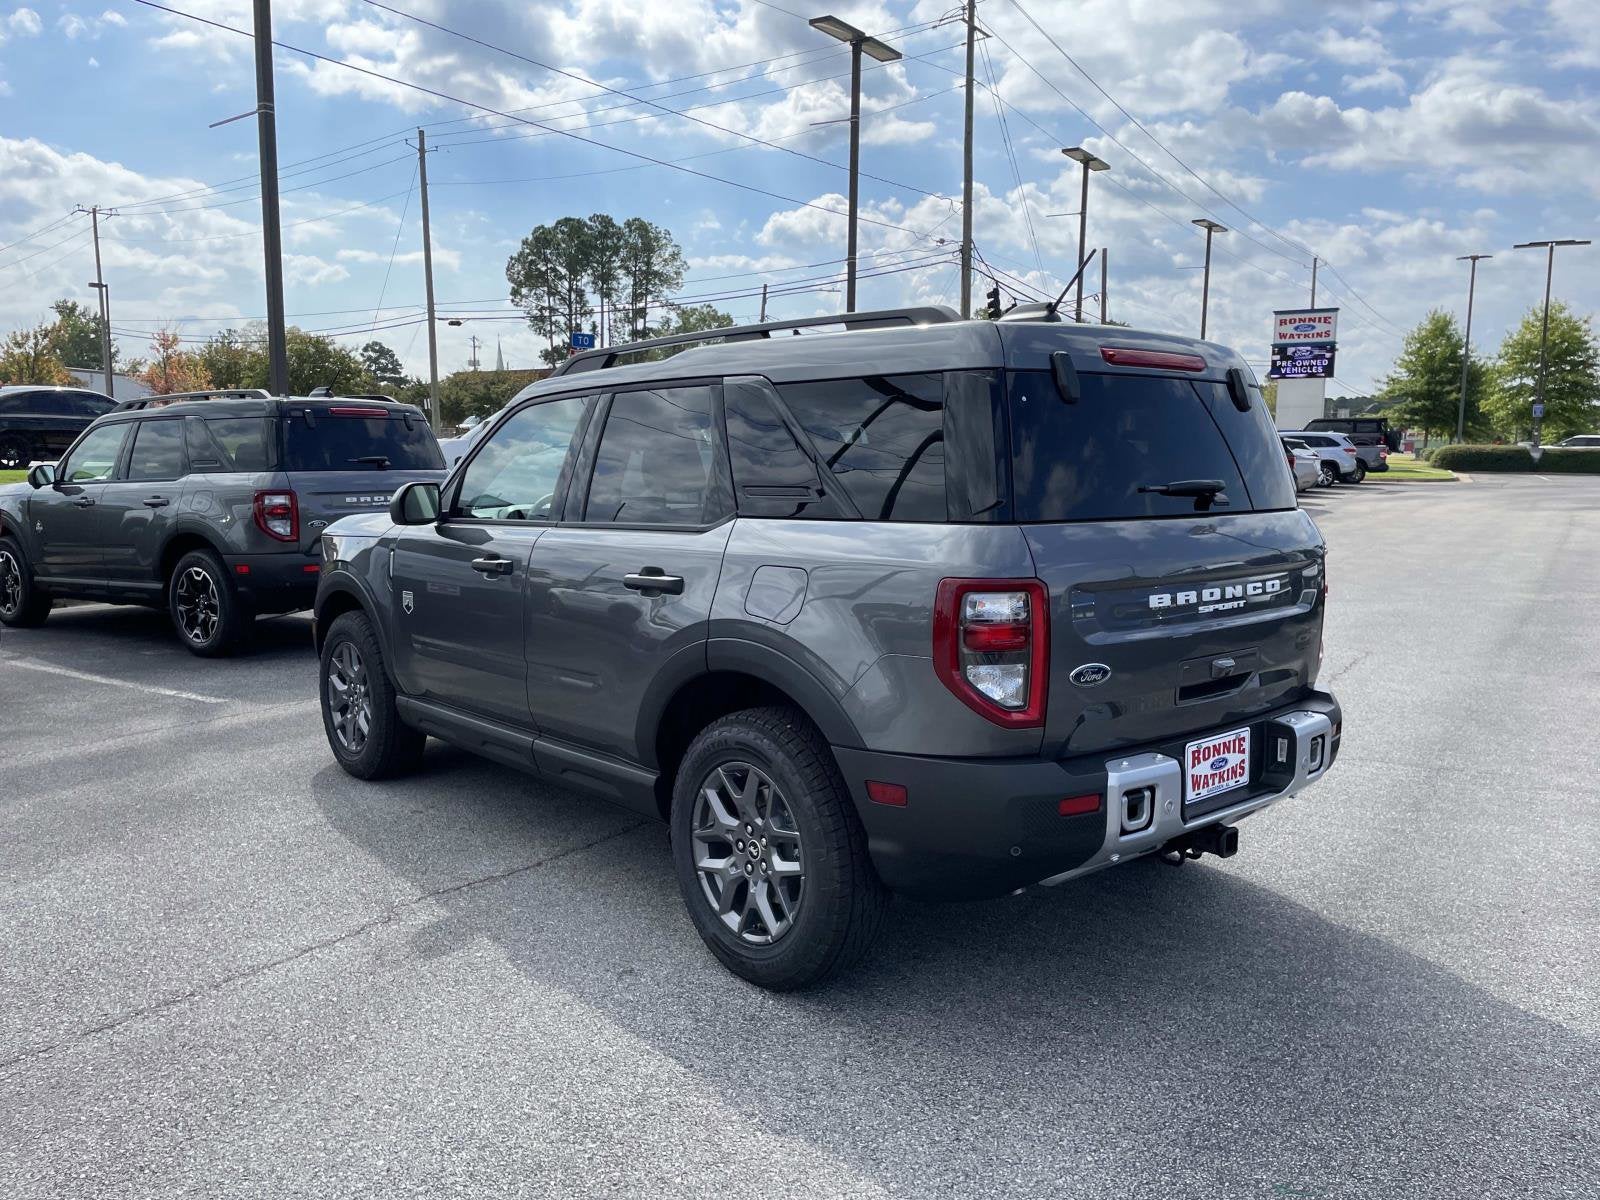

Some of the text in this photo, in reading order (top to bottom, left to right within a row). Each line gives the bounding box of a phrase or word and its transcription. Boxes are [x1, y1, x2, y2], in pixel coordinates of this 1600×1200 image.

[1280, 316, 1332, 326] RONNIE
[1295, 324, 1314, 332] Ford
[1279, 330, 1331, 340] WATKINS
[1276, 359, 1329, 367] PRE-OWNED
[1280, 366, 1323, 374] VEHICLES
[1149, 579, 1281, 609] BRONCO
[1198, 600, 1247, 613] SPORT
[1080, 668, 1104, 683] Ford
[1191, 736, 1246, 769] RONNIE
[1211, 757, 1227, 769] Ford
[1191, 758, 1246, 792] WATKINS
